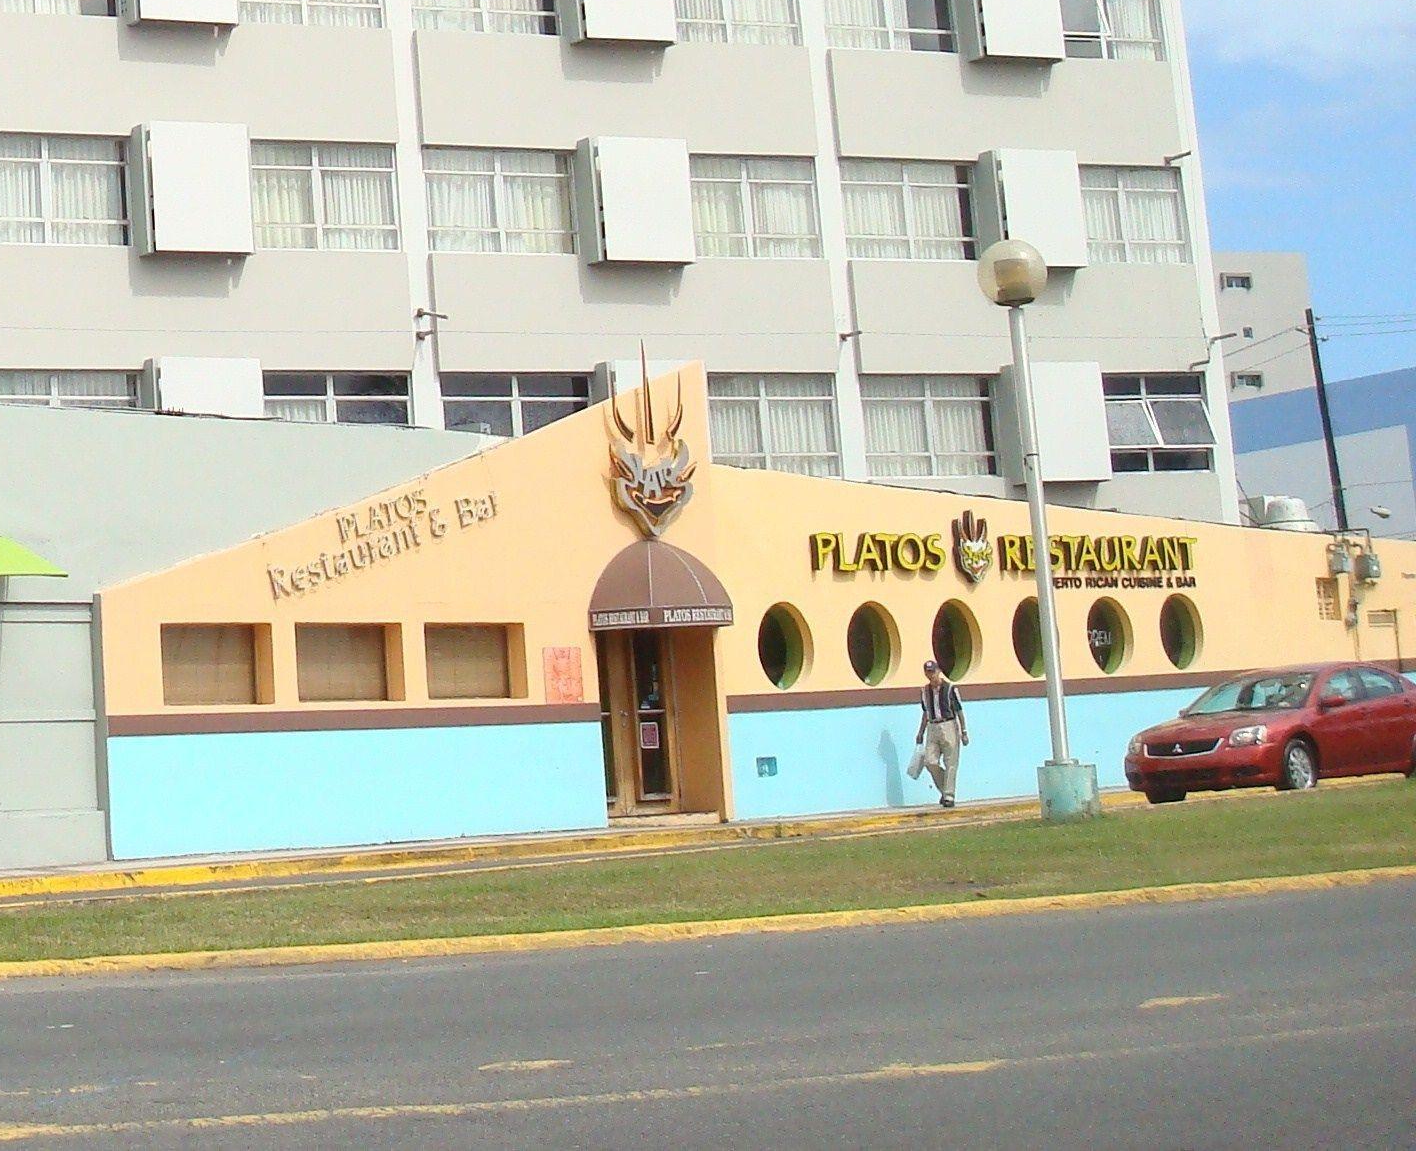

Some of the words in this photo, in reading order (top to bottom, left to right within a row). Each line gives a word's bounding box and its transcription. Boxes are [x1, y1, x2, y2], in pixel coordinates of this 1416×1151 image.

[336, 489, 428, 543] PLATOS
[267, 519, 422, 602] Restaurant
[429, 508, 449, 538] &
[810, 531, 947, 572] PLATOS
[1085, 576, 1118, 589] RICAN
[1122, 576, 1163, 589] CUISINE
[1166, 577, 1173, 588] &
[1176, 576, 1197, 589] BAR
[664, 609, 691, 623] PLATOS
